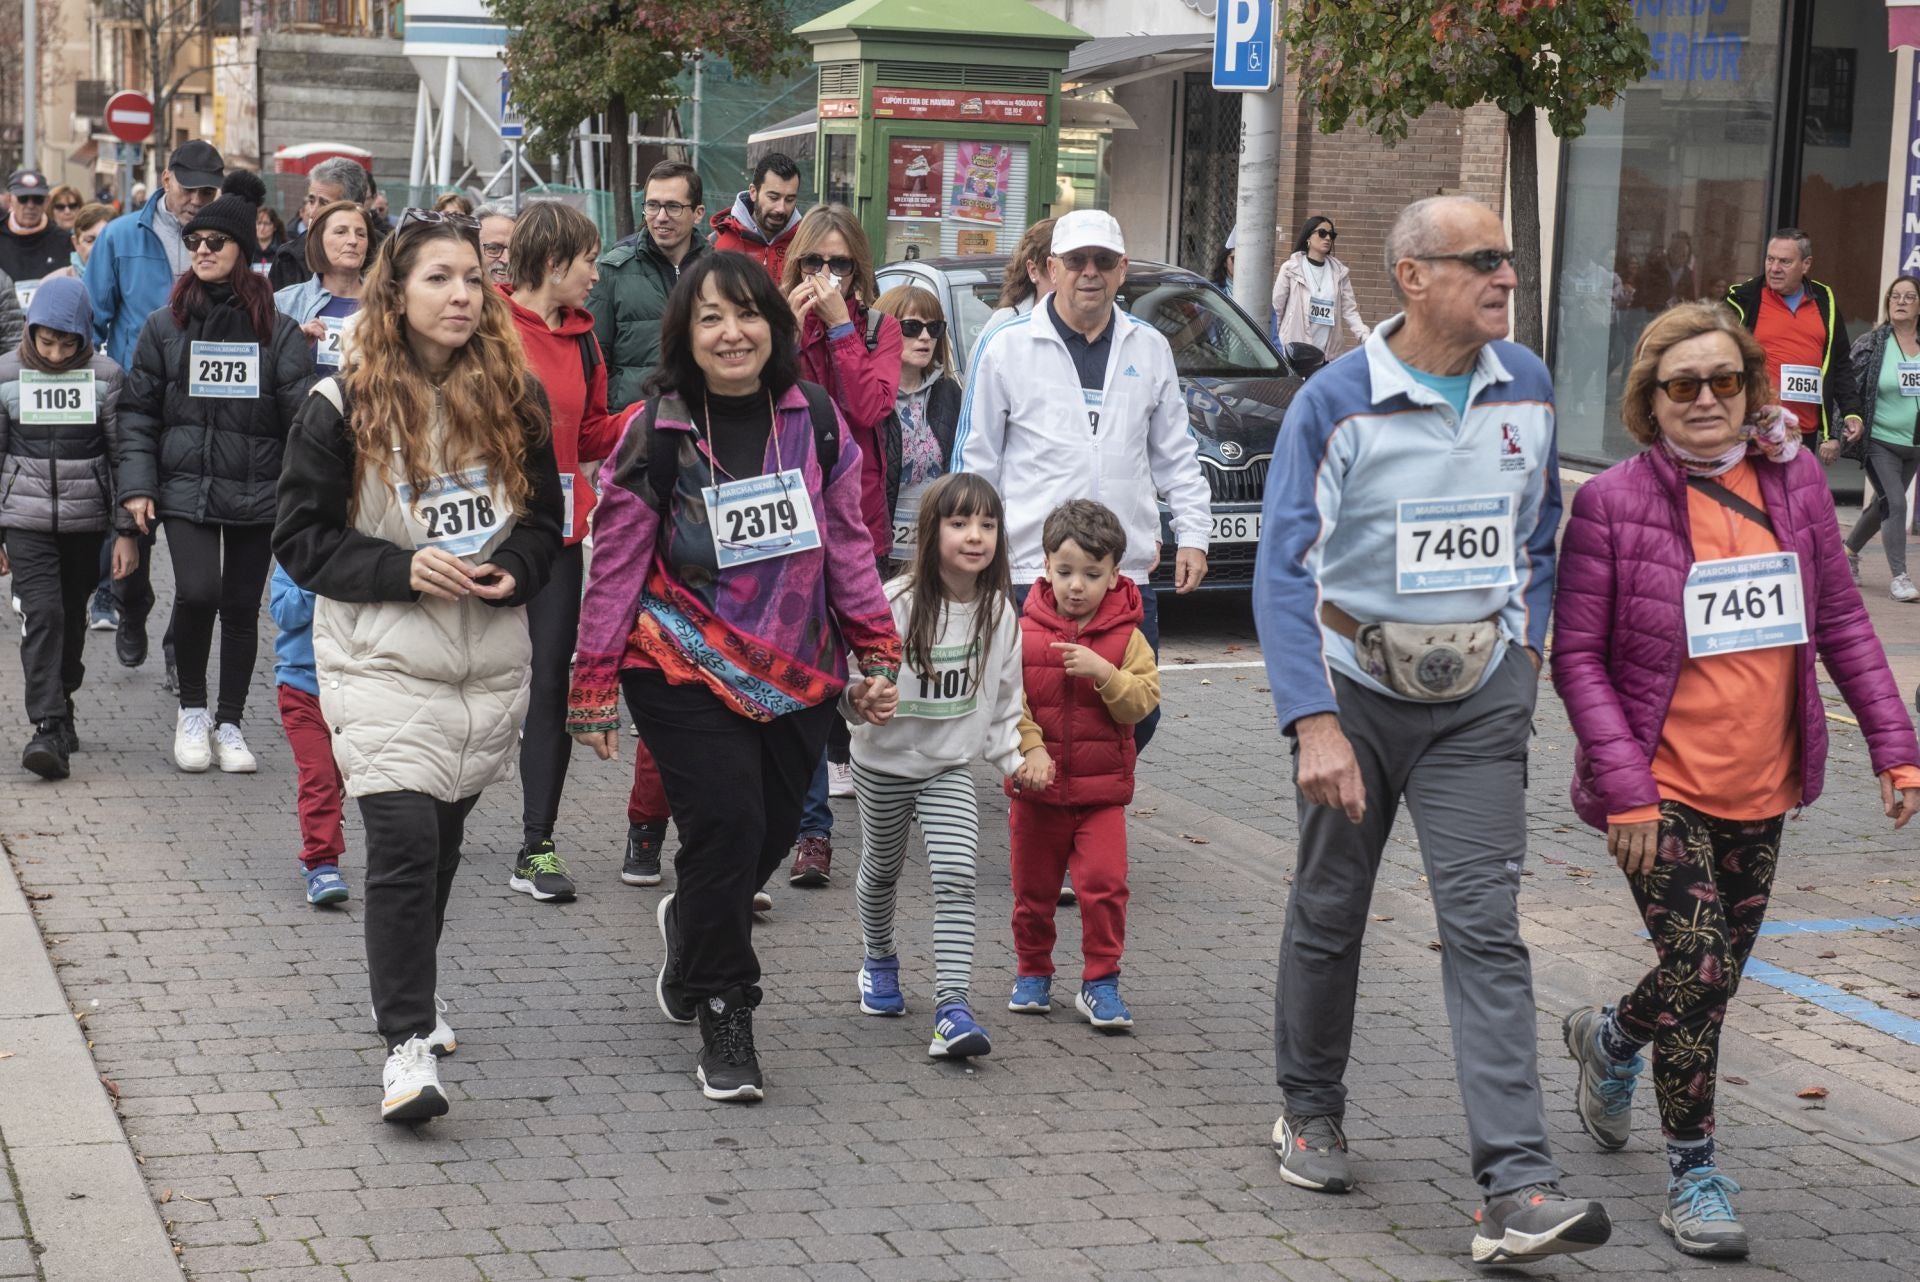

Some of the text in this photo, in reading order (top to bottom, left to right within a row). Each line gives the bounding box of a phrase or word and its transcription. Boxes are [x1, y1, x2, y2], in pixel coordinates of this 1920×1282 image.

[1225, 0, 1259, 71] P
[882, 96, 902, 105] CUPÓN
[903, 97, 921, 105] EXTRA
[930, 98, 956, 107] NAVIDAD
[1311, 305, 1330, 318] 2042
[329, 333, 340, 351] 2
[199, 360, 247, 383] 2373
[1787, 376, 1818, 393] 2654
[33, 388, 81, 410] 1103
[421, 495, 496, 538] 2378
[725, 499, 798, 542] 2379
[1415, 504, 1456, 515] MARCHA
[1412, 526, 1500, 562] 7460
[1698, 566, 1736, 577] MARCHA
[1697, 583, 1784, 625] 7461
[916, 666, 969, 699] 1107
